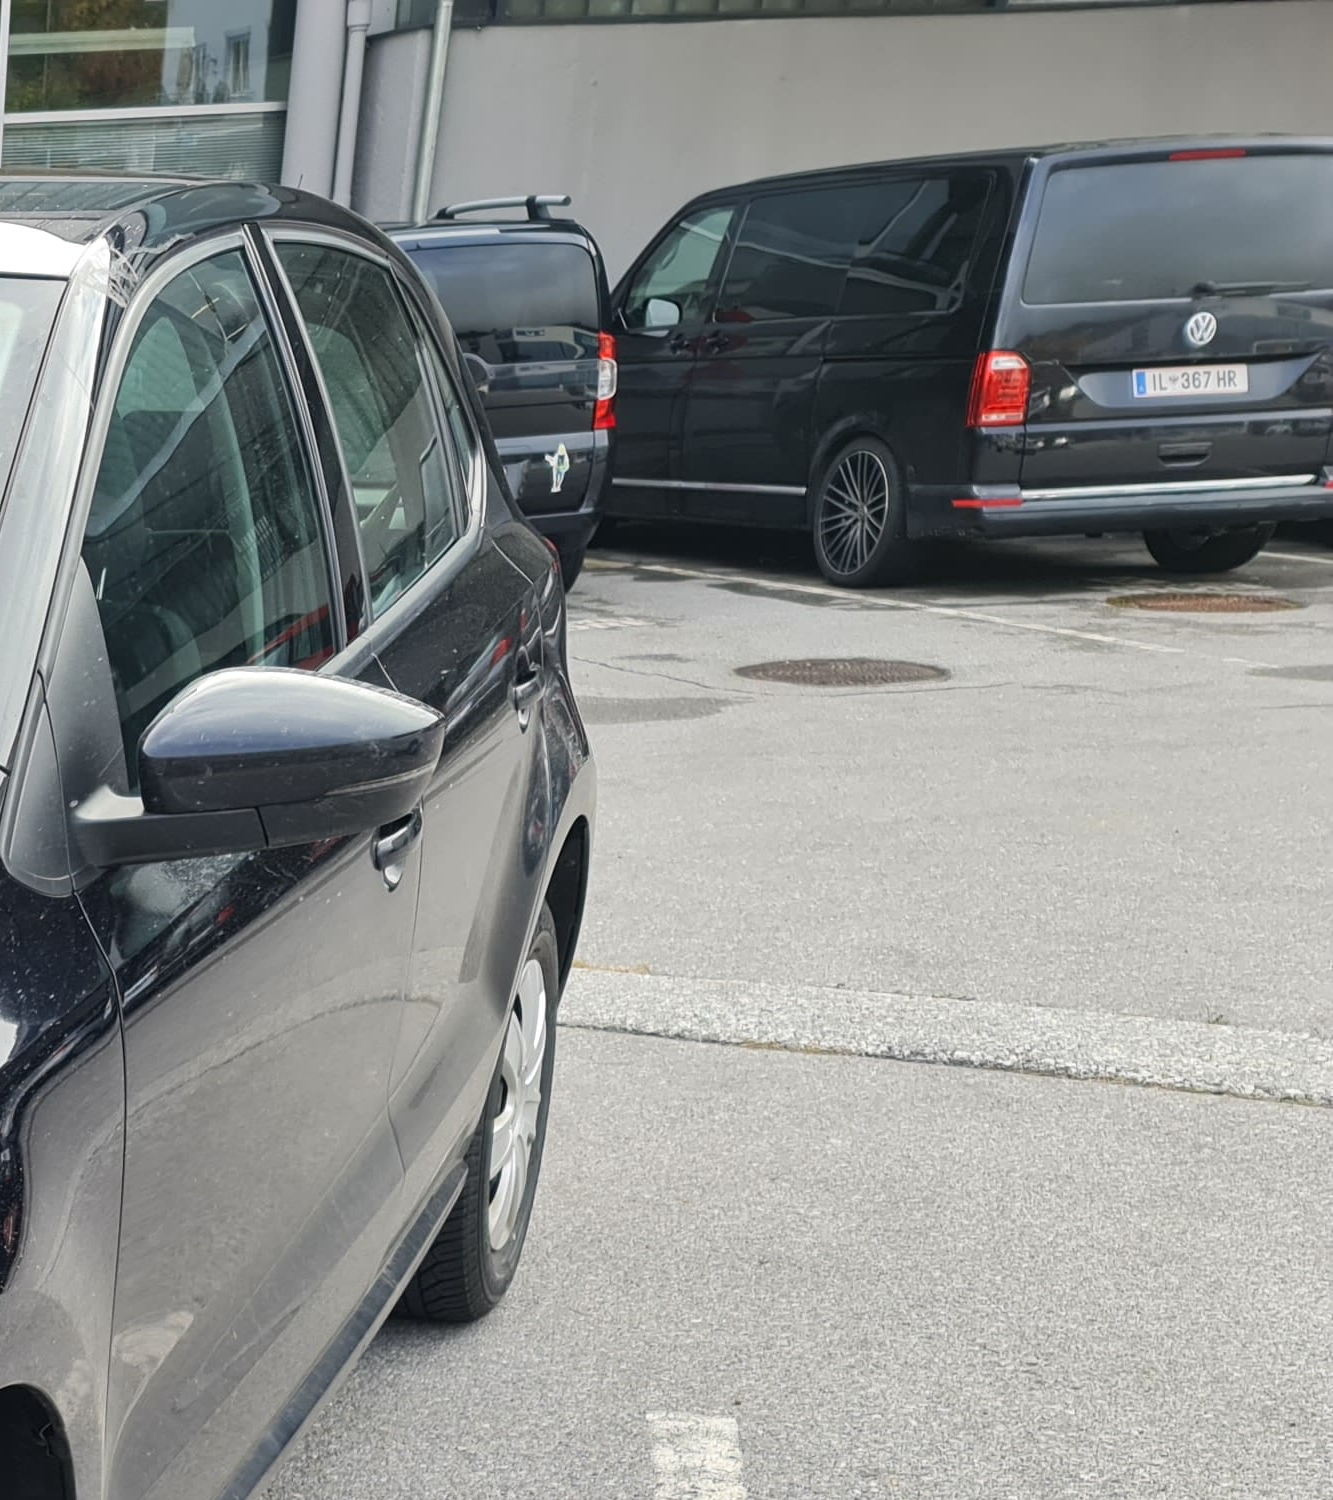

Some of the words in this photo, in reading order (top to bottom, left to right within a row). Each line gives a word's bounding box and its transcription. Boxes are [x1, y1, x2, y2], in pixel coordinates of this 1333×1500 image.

[1152, 373, 1168, 391] IL
[1181, 371, 1212, 389] 367
[1216, 369, 1238, 388] HR
